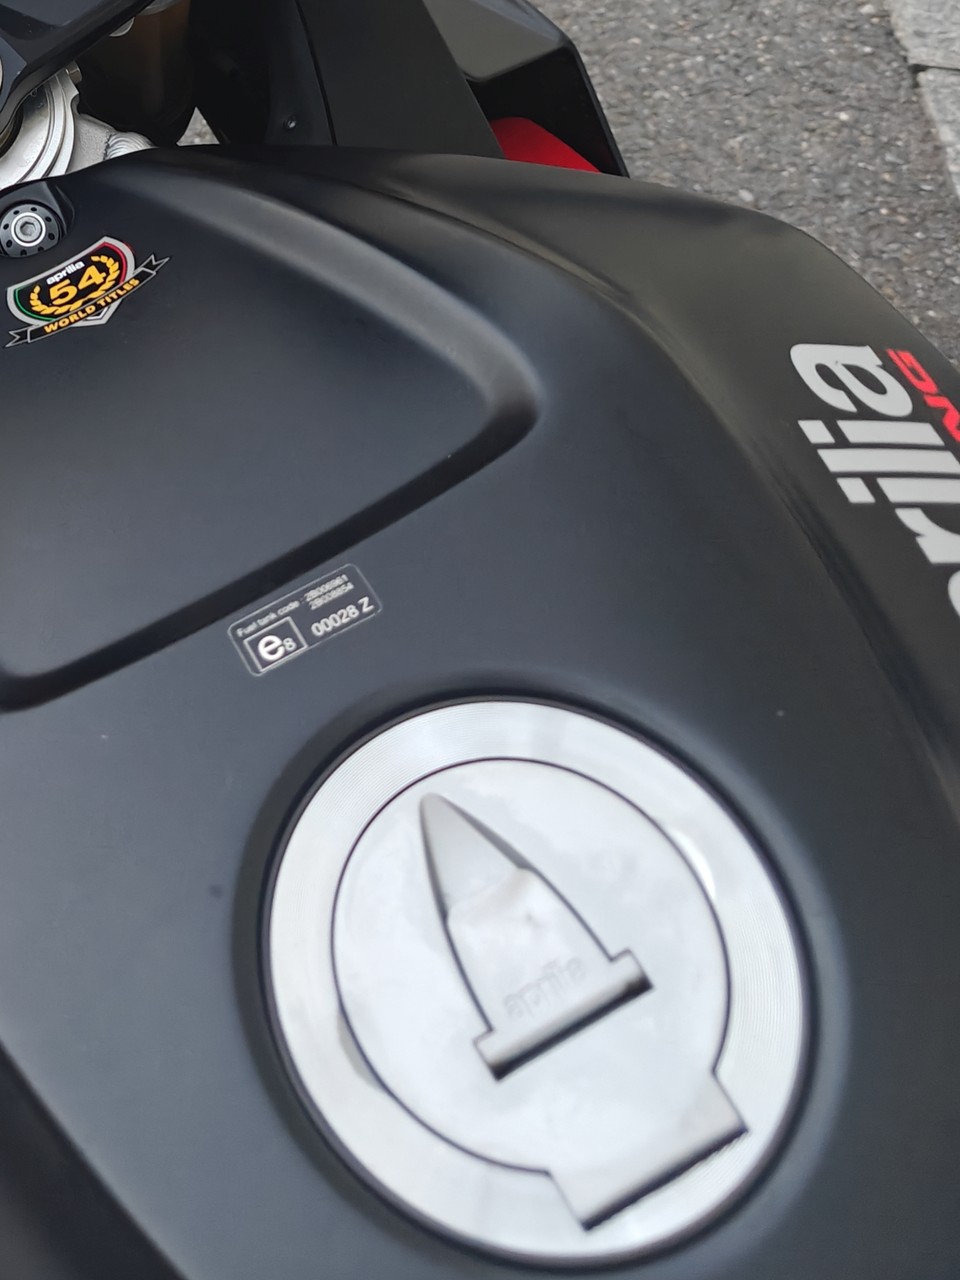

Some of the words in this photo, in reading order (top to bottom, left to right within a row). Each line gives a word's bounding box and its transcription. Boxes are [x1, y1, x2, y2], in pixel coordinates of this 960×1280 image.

[46, 261, 85, 285] aprilia
[49, 265, 107, 306] 54
[44, 305, 96, 333] WORLD
[97, 278, 140, 307] TITLES
[236, 622, 258, 637] Fuel
[257, 612, 278, 626] tank
[277, 601, 300, 616] code
[311, 604, 360, 637] 00028
[358, 596, 375, 613] Z
